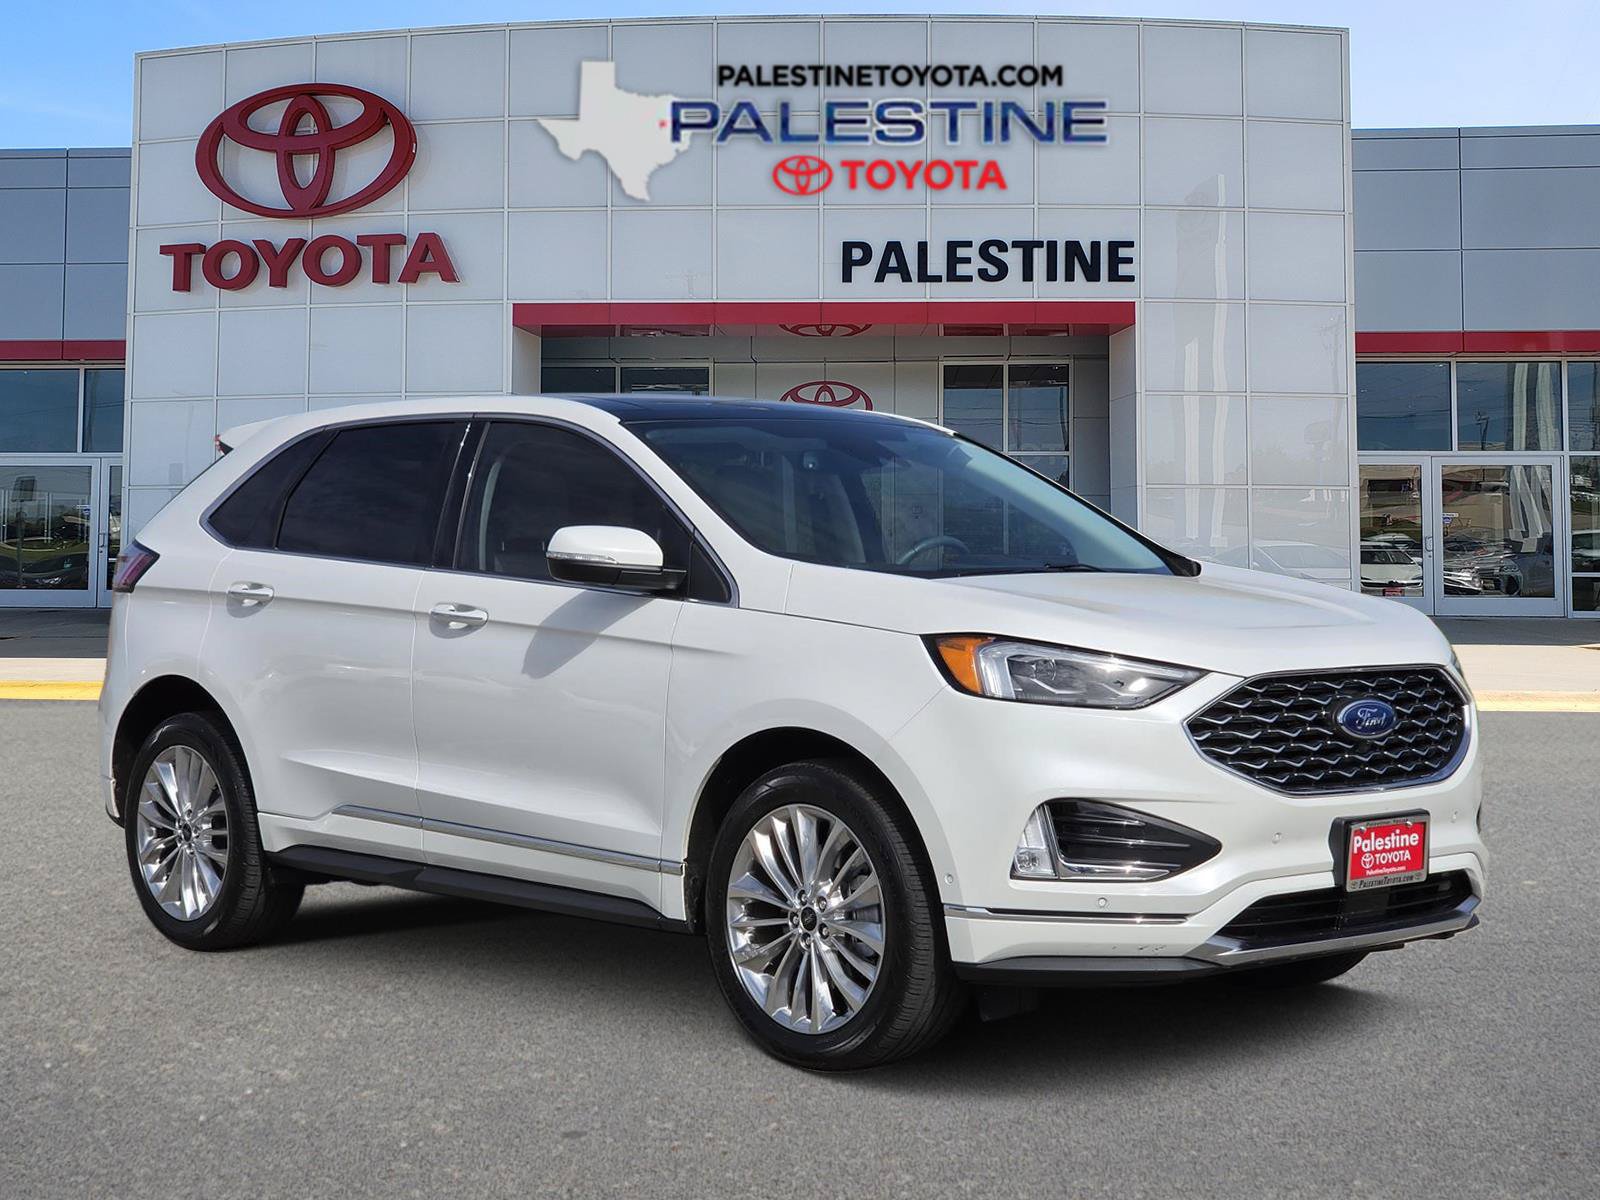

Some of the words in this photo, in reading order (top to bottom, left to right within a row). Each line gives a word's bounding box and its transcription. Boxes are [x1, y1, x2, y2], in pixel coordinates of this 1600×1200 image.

[159, 232, 460, 292] TOYOTA
[842, 240, 1135, 283] PALESTINE
[1353, 829, 1419, 854] Palestine
[1374, 849, 1411, 865] TOYOTA
